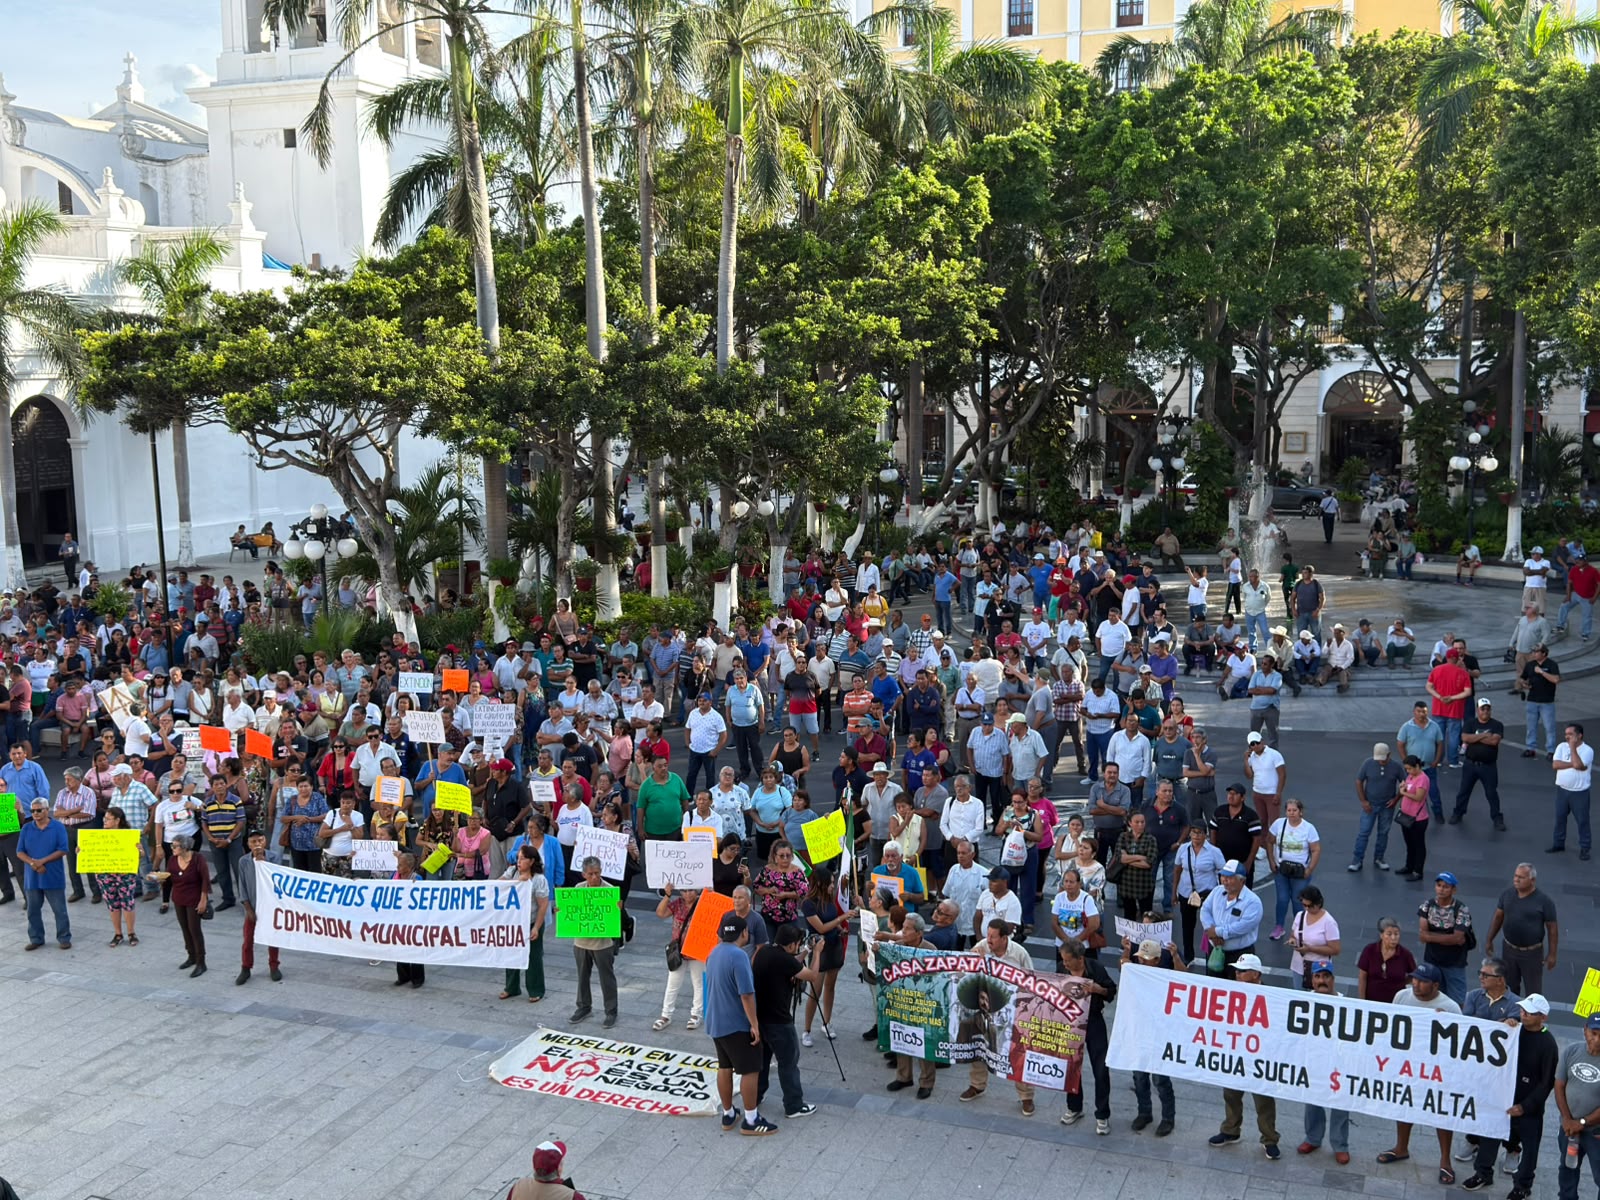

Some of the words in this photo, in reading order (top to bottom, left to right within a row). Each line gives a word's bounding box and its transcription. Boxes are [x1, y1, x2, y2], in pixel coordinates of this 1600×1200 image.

[354, 840, 395, 852] EXTINCION
[655, 843, 687, 859] Fuera
[354, 858, 387, 870] REQUISA
[674, 859, 705, 870] Grupo
[661, 872, 694, 886] MAS
[271, 872, 369, 907] QUEREMOS
[371, 886, 405, 912] QUE
[407, 886, 486, 910] SEFORME
[493, 886, 521, 910] LA
[273, 908, 353, 940] COMISION
[360, 922, 467, 947] MUNICIPAL
[470, 928, 486, 944] DE
[486, 925, 526, 947] AGUA
[579, 922, 606, 933] MAS
[882, 959, 925, 983] CASA
[924, 955, 987, 974] ZAPATA
[989, 958, 1084, 1023] VERACRUZ
[1018, 1020, 1041, 1032] EXIGE
[1041, 1026, 1082, 1042] EXTINCION
[1031, 1015, 1040, 1024] EL
[1041, 1018, 1071, 1032] PUEBLO
[1164, 981, 1270, 1029] FUERA
[1287, 1000, 1412, 1051] GRUPO
[1430, 1019, 1508, 1067] MAS
[1019, 1036, 1029, 1045] AL
[1031, 1039, 1057, 1052] GRUPO
[1058, 1046, 1076, 1056] MAS
[1036, 1032, 1068, 1047] REQUISA
[1192, 1026, 1260, 1053] ALTO
[540, 1033, 644, 1056] MEDELLIN
[645, 1050, 677, 1063] EN
[679, 1054, 720, 1071] LUC
[542, 1045, 574, 1059] EL
[613, 1059, 705, 1083] AGUA
[949, 1051, 975, 1060] PEDRO
[1162, 1042, 1187, 1065] AL
[1195, 1049, 1246, 1078] AGUA
[1253, 1059, 1310, 1089] SUCIA
[1376, 1055, 1389, 1072] Y
[1399, 1060, 1413, 1078] A
[1419, 1062, 1443, 1083] LA
[594, 1075, 711, 1100] NEGOCIO
[603, 1067, 650, 1081] ES
[662, 1076, 708, 1091] UN
[501, 1075, 538, 1089] ES
[538, 1080, 574, 1097] UN
[574, 1089, 690, 1116] DERECHO
[1329, 1067, 1341, 1094] $
[1346, 1074, 1414, 1108] TARIFA
[1422, 1088, 1477, 1121] ALTA
